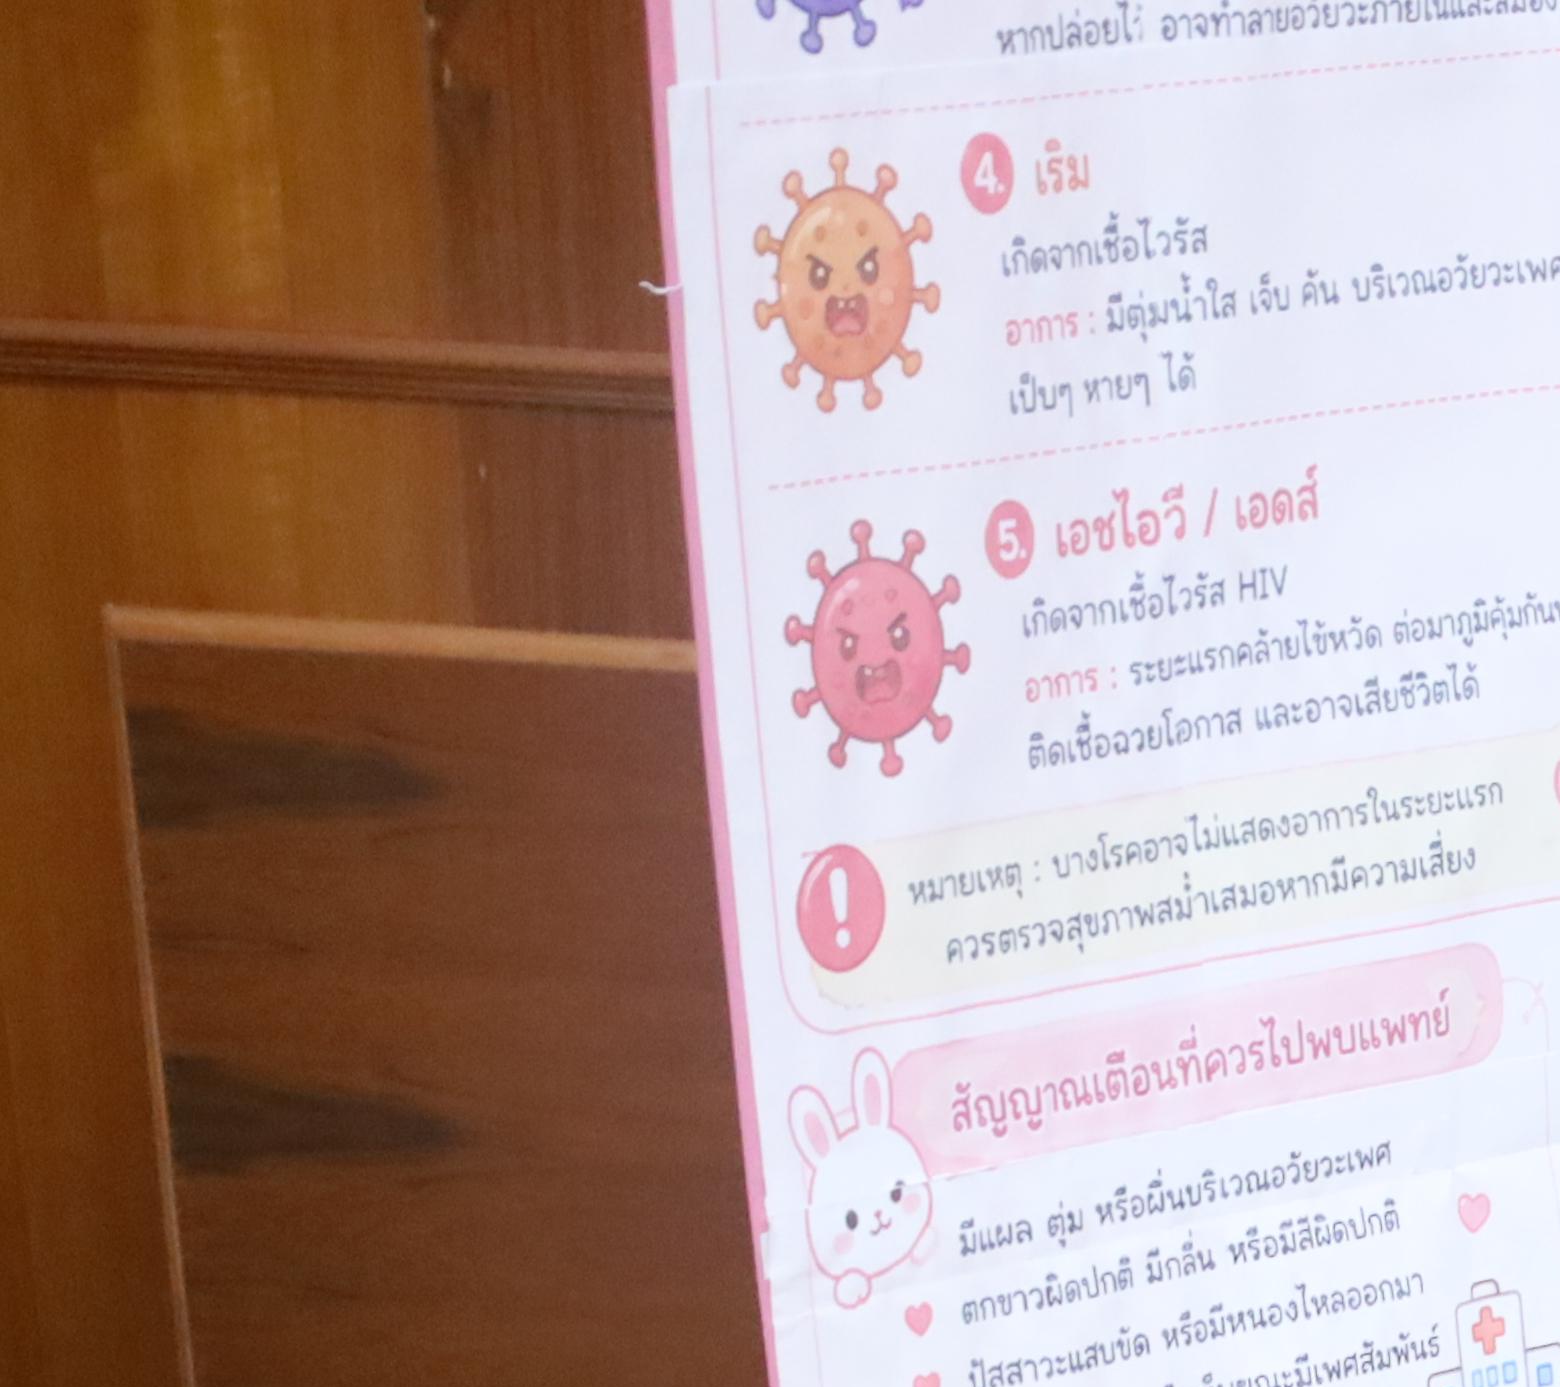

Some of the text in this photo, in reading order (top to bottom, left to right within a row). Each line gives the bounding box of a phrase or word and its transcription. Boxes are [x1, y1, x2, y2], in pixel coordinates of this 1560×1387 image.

[1034, 138, 1092, 197] เริม
[1000, 213, 1210, 278] เกิดจากเชื้อไวรัส
[1004, 310, 1079, 347] อาการ
[1249, 279, 1292, 319] เจ็บ
[1300, 268, 1340, 310] คัน
[1162, 355, 1198, 394] ได้
[1056, 482, 1186, 558] เอชไอวี
[1234, 464, 1321, 532] เอดส์
[1021, 565, 1289, 639] เกิดจากเชื้อไวรัส HIV
[1025, 666, 1098, 702] อาการ
[908, 858, 1024, 907] หมายเหตุ
[959, 1218, 1034, 1258] มีแผล
